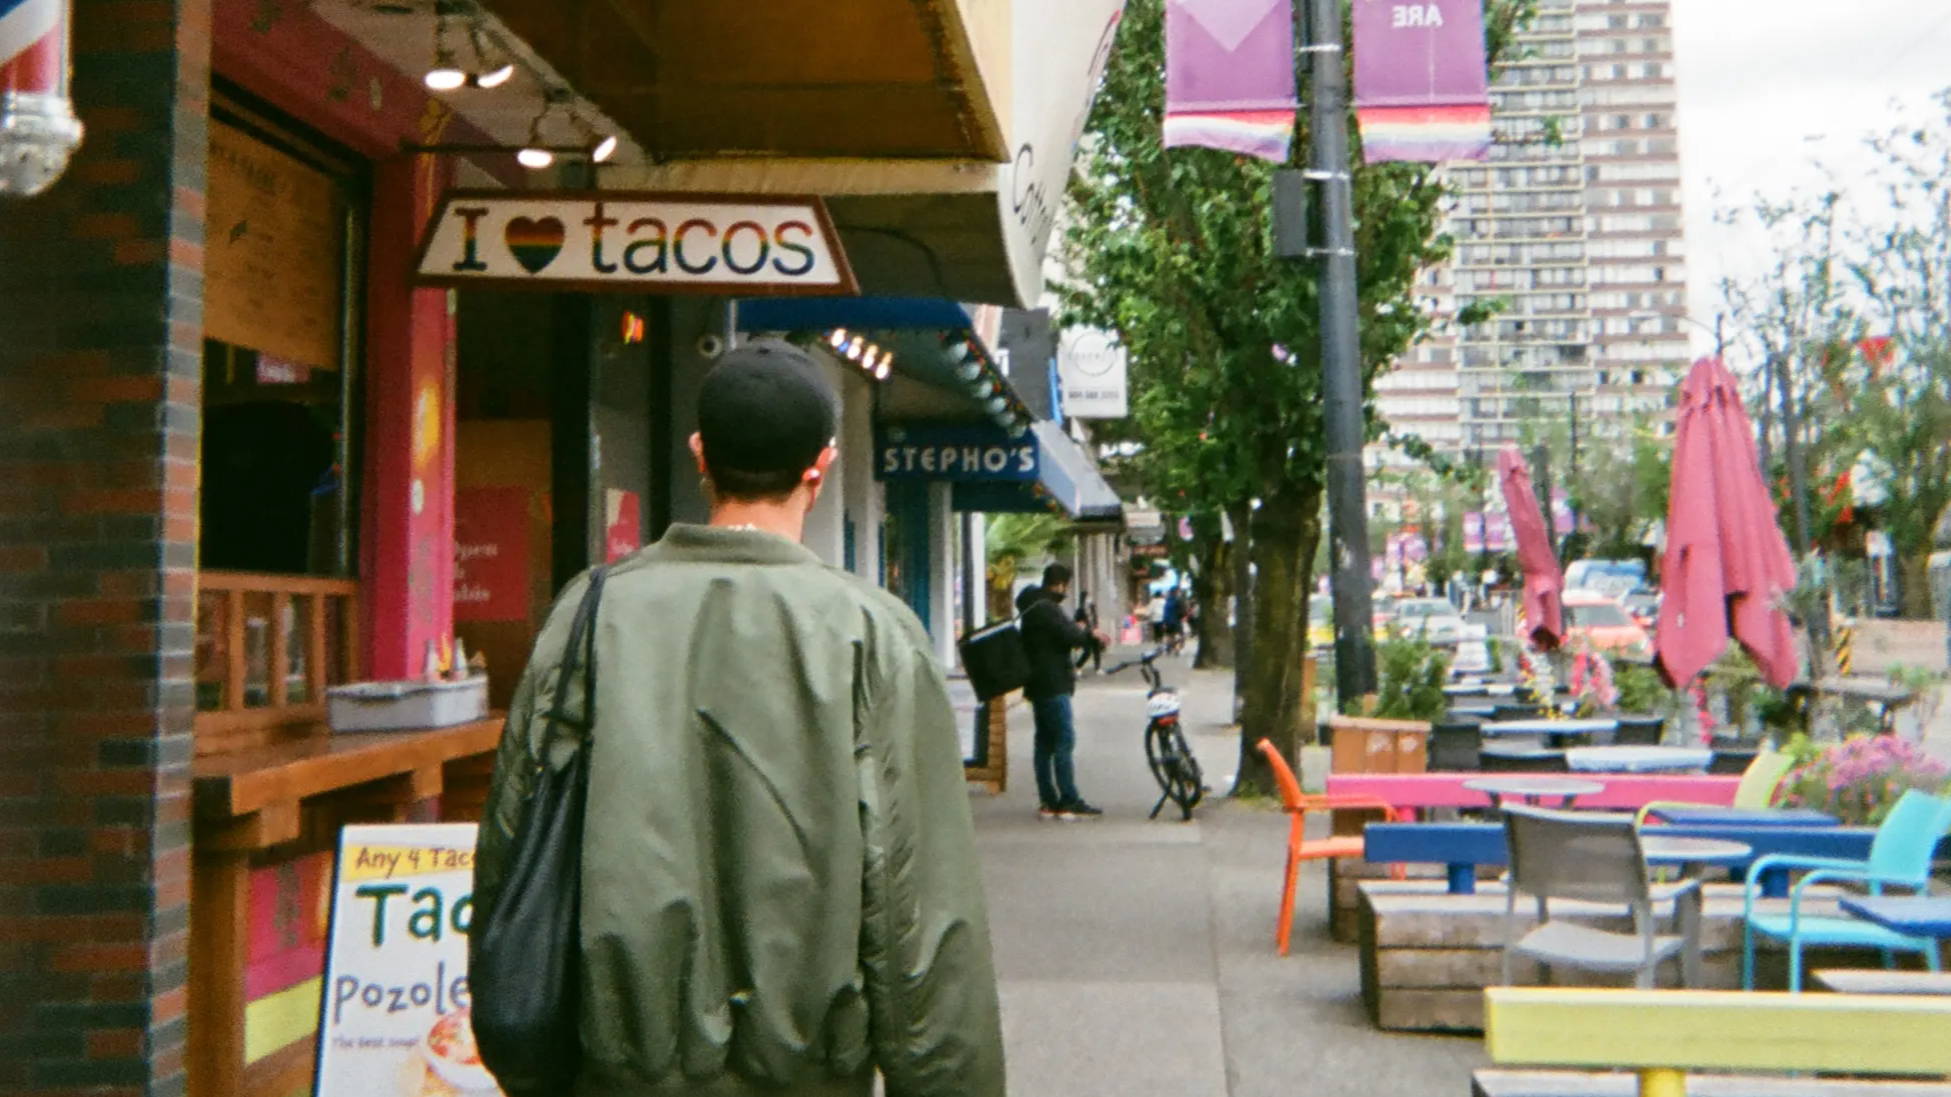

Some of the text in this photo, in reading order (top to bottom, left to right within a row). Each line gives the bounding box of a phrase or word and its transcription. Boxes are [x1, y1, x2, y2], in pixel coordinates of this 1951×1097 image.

[452, 201, 816, 276] I tacos
[883, 446, 1036, 473] STEPHO'S
[355, 847, 476, 880] Any 4 Tac
